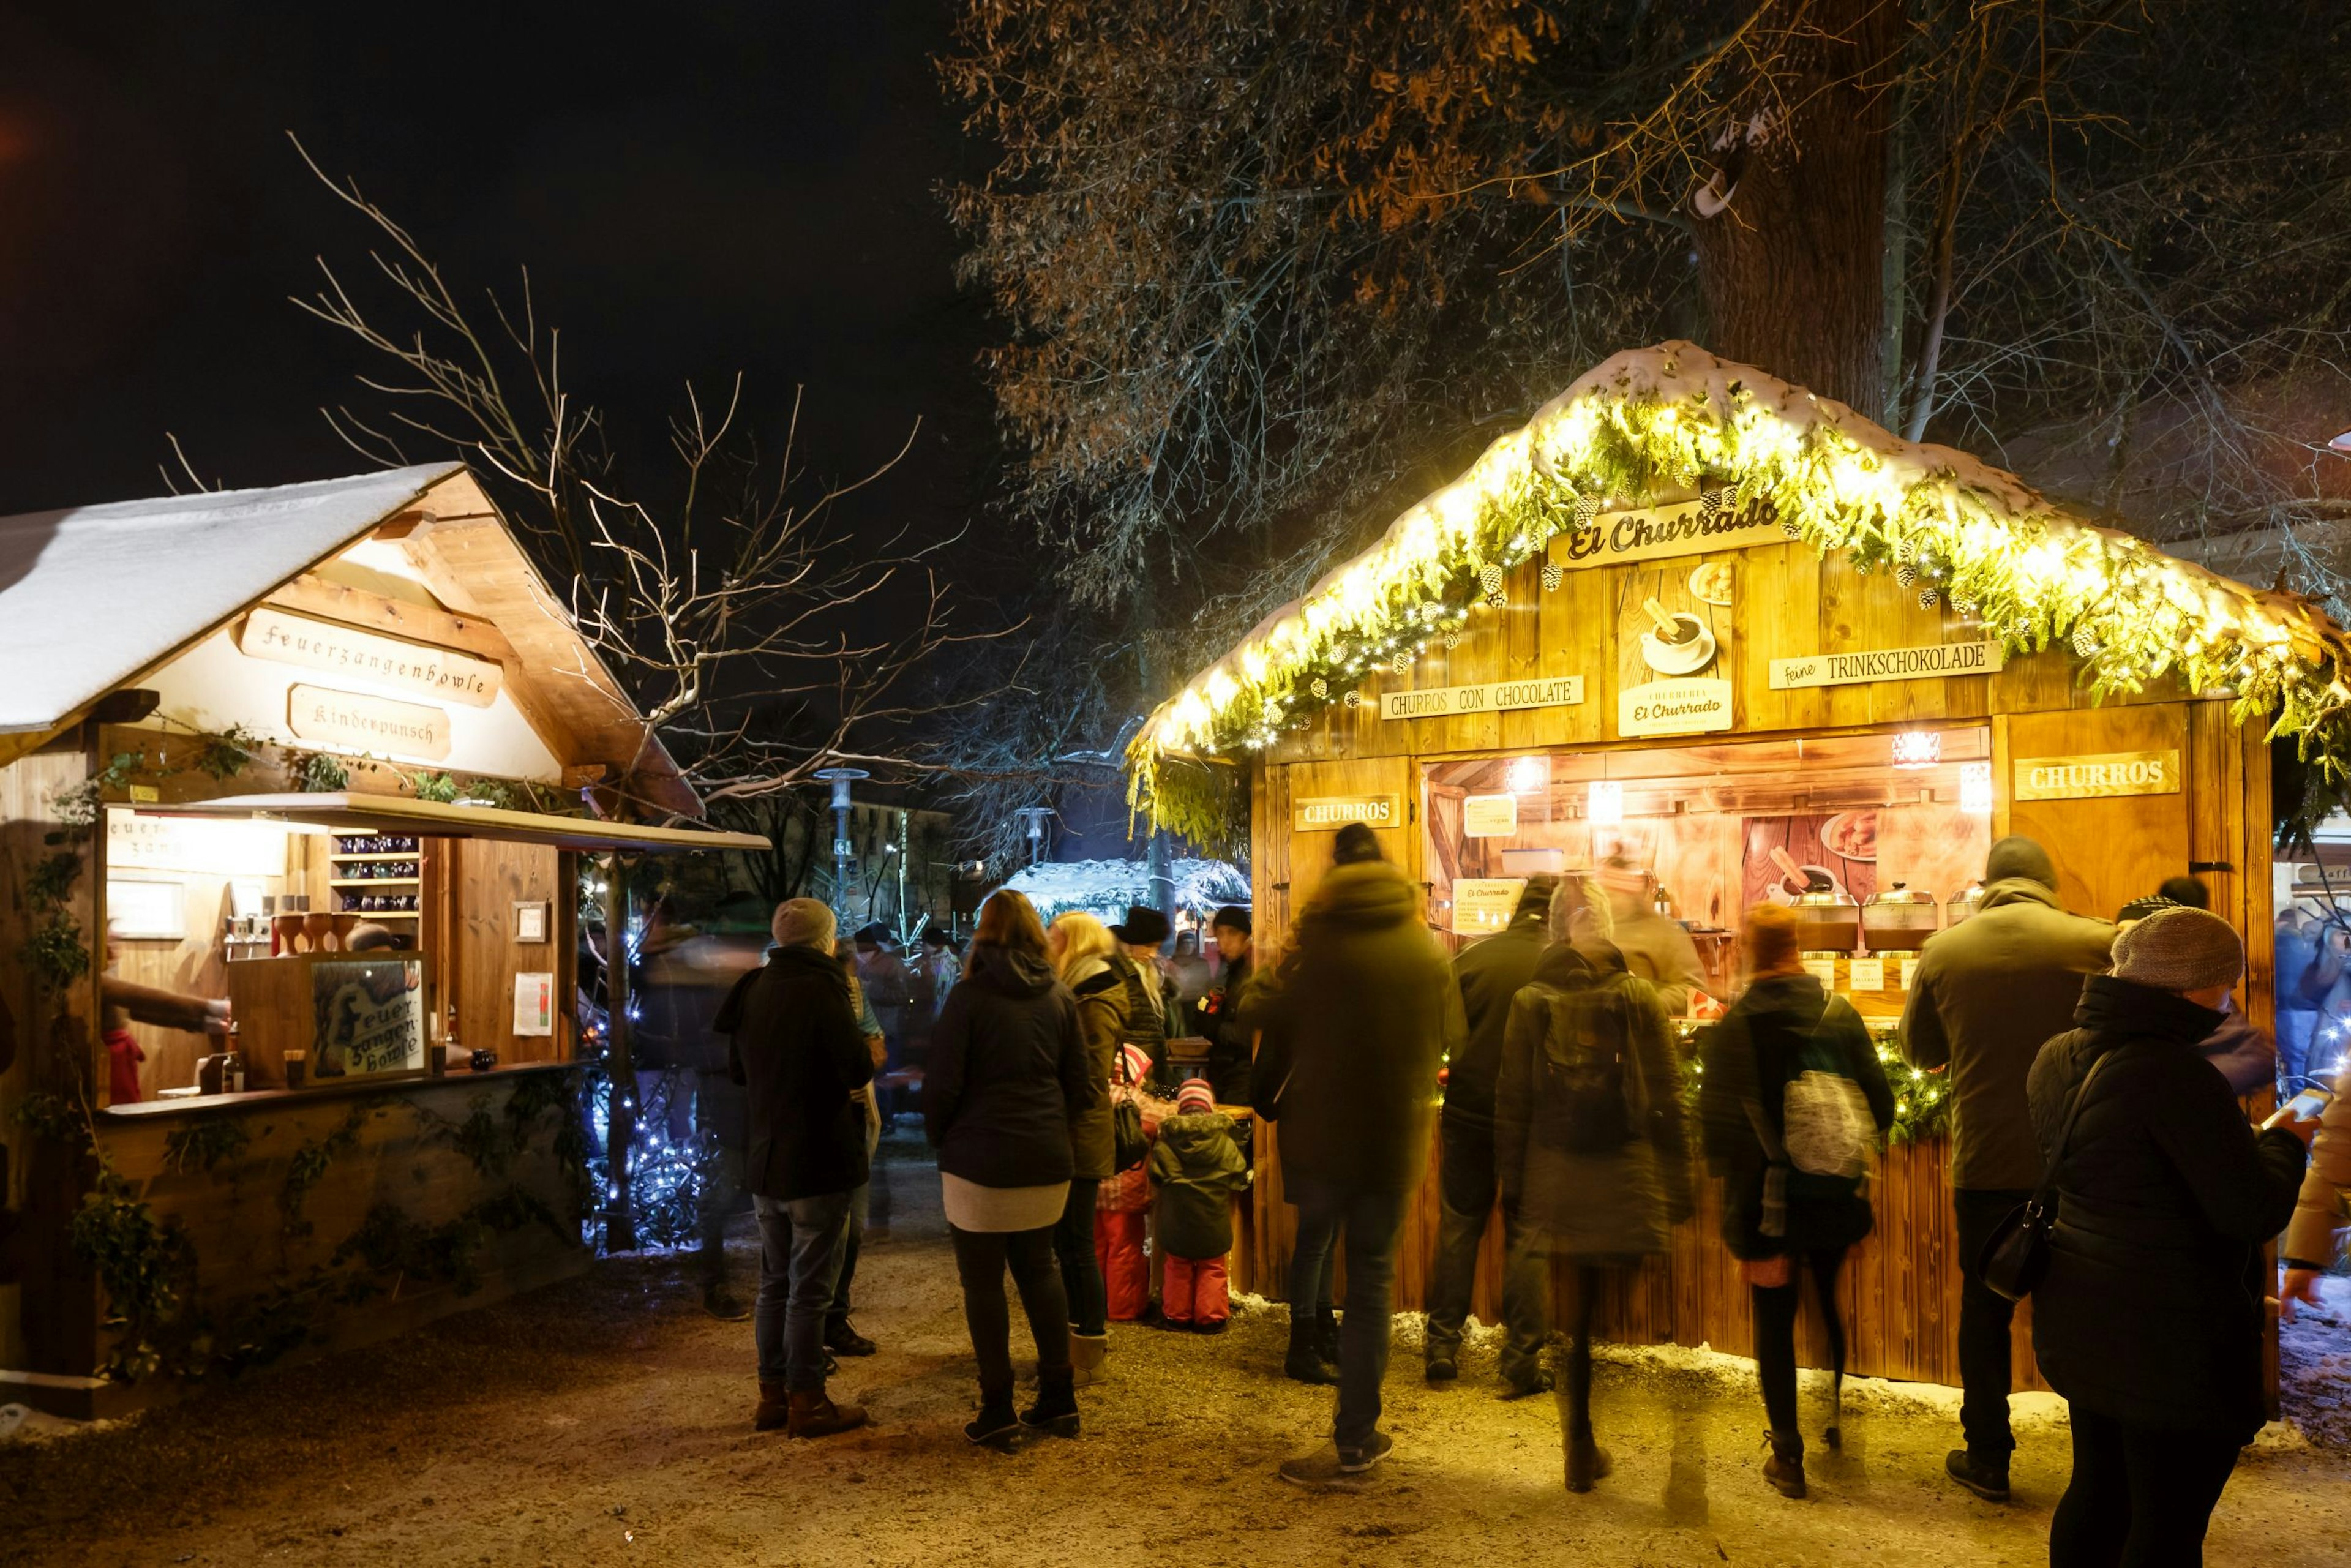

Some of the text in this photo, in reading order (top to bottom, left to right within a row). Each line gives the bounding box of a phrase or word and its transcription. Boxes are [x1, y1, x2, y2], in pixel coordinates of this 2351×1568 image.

[1568, 497, 1779, 560] El Churrado
[1784, 645, 1986, 686] feine TRINKSCHOKOLADE
[1392, 681, 1572, 715] CHURROS CON CHOCOLATE
[1634, 699, 1722, 721] El Churrado
[313, 704, 433, 745] Kinderpunsch
[2030, 760, 2164, 789] CHURROS
[1304, 801, 1389, 823] CHURROS
